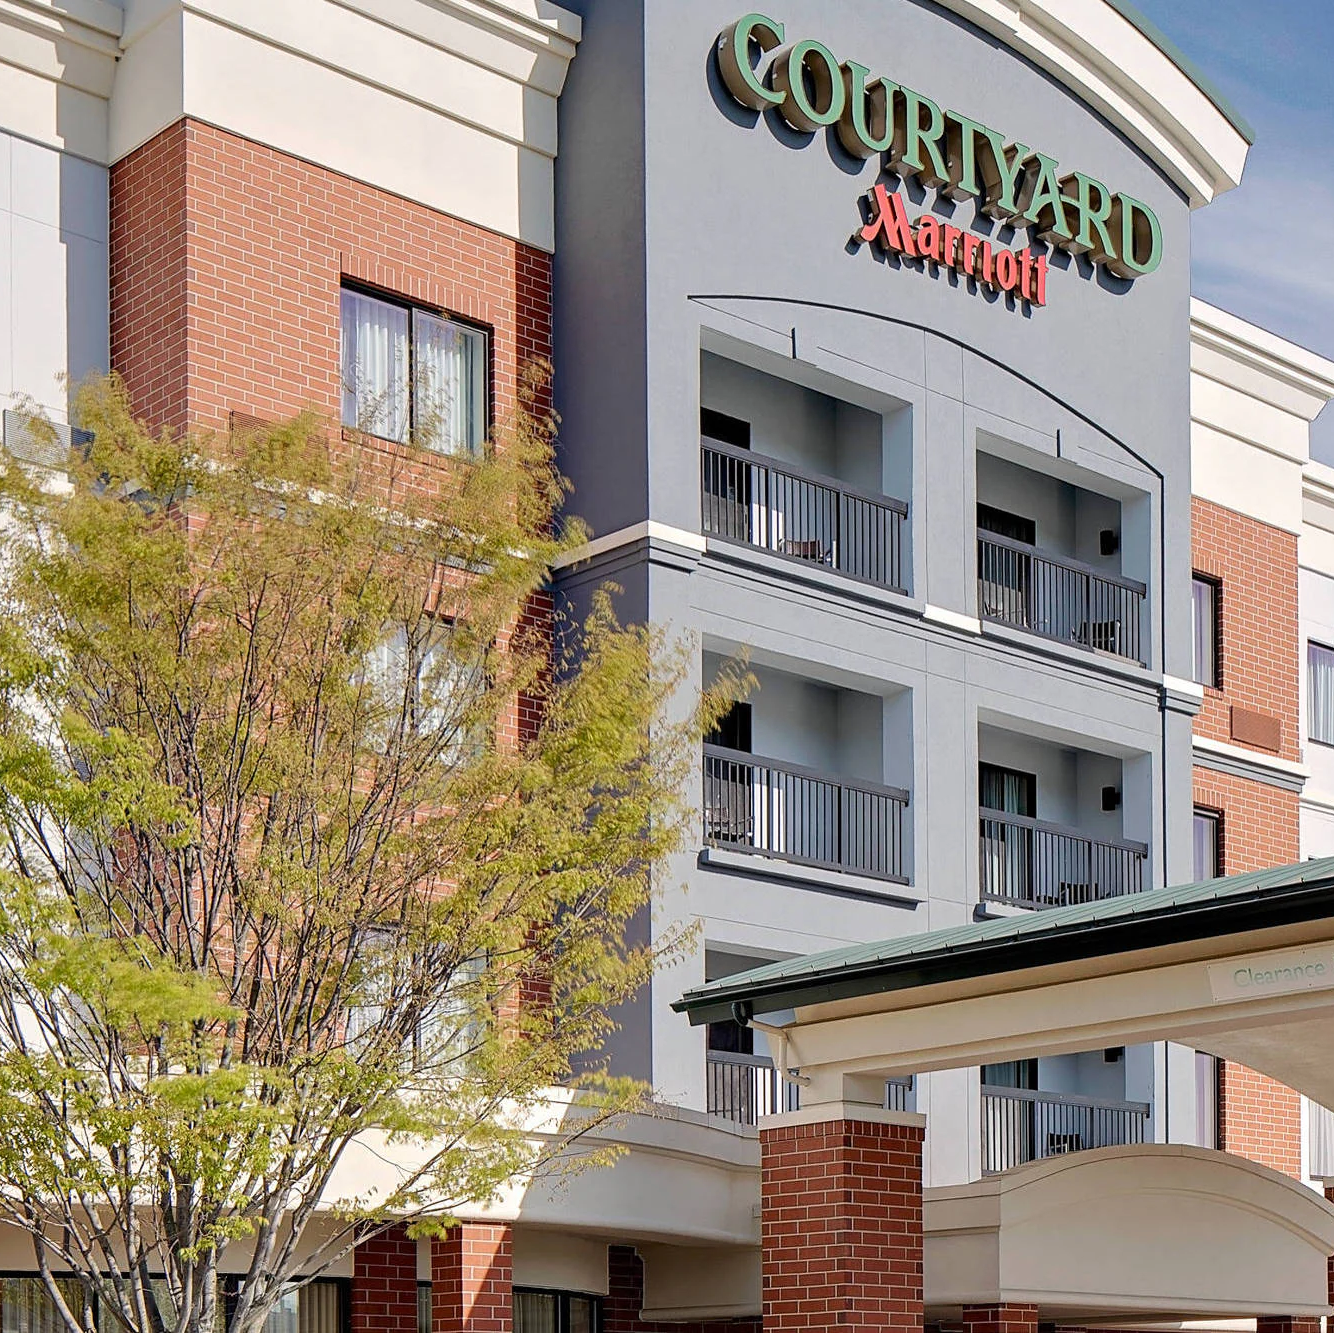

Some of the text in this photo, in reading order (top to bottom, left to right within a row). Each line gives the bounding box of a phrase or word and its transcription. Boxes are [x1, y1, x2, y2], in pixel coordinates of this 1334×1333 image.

[718, 13, 1163, 277] COURTYARD
[860, 183, 1049, 306] Marriott
[1233, 961, 1325, 988] Clearance
